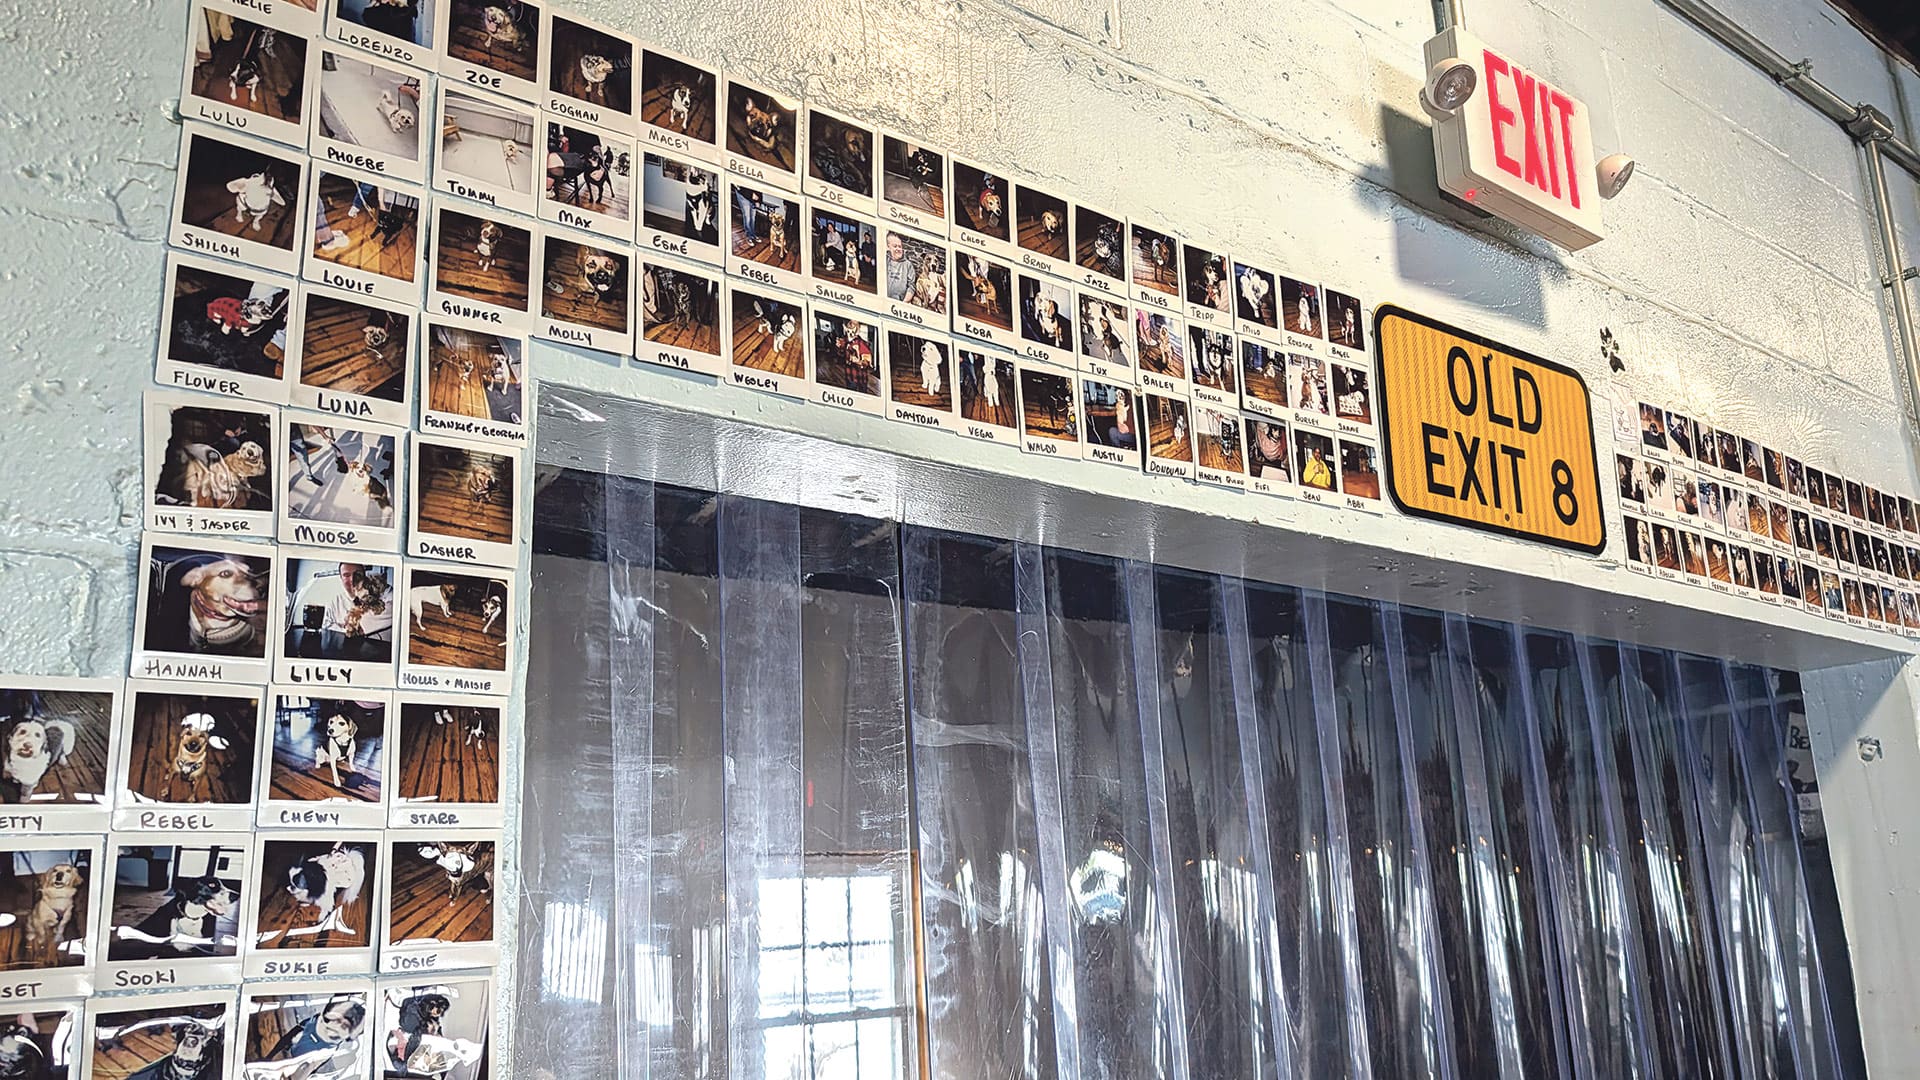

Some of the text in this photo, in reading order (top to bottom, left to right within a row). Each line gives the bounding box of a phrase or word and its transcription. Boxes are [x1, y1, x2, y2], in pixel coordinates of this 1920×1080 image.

[338, 27, 413, 62] LORENZO
[465, 70, 502, 88] ZOE
[199, 106, 247, 128] LULU
[550, 100, 600, 123] EOGHAN
[1483, 48, 1581, 209] EXIT
[648, 129, 689, 151] MACEY
[327, 147, 385, 172] PHOEBE
[729, 159, 764, 180] BELLA
[819, 185, 844, 203] ZOE
[558, 209, 593, 229] MAX
[182, 233, 240, 258] SHILOH
[960, 232, 986, 247] CHLOE
[1022, 254, 1052, 271] BRADY
[322, 269, 374, 294] LOUIE
[740, 264, 778, 285] REBEL
[1084, 274, 1111, 291] JAZZ
[816, 285, 855, 305] SAILOR
[441, 301, 503, 325] GUNNER
[1190, 306, 1214, 322] TRIPP
[548, 324, 592, 346] MOLLY
[965, 323, 992, 340] KOBA
[658, 352, 689, 369] MYA
[1026, 346, 1049, 361] CLEO
[1089, 362, 1107, 376] TUX
[173, 370, 244, 396] FLOWER
[1143, 375, 1174, 392] BAILEY
[1447, 346, 1542, 434] OLD
[316, 392, 373, 417] LUNA
[896, 409, 940, 426] DAYTONA
[968, 426, 994, 439] VEGAS
[1093, 449, 1124, 462] AUSTIN
[1421, 421, 1578, 526] EXIT 8
[155, 514, 177, 528] IVY
[419, 542, 476, 560] DASHER
[145, 659, 223, 680] HANNAH
[290, 665, 353, 683] LILLY
[140, 811, 214, 830] REBEL
[280, 811, 340, 826] CHEWY
[410, 813, 460, 825] STARR
[264, 960, 329, 976] SUKIE
[390, 954, 437, 970] JOSIE
[115, 968, 176, 987] SOOKI
